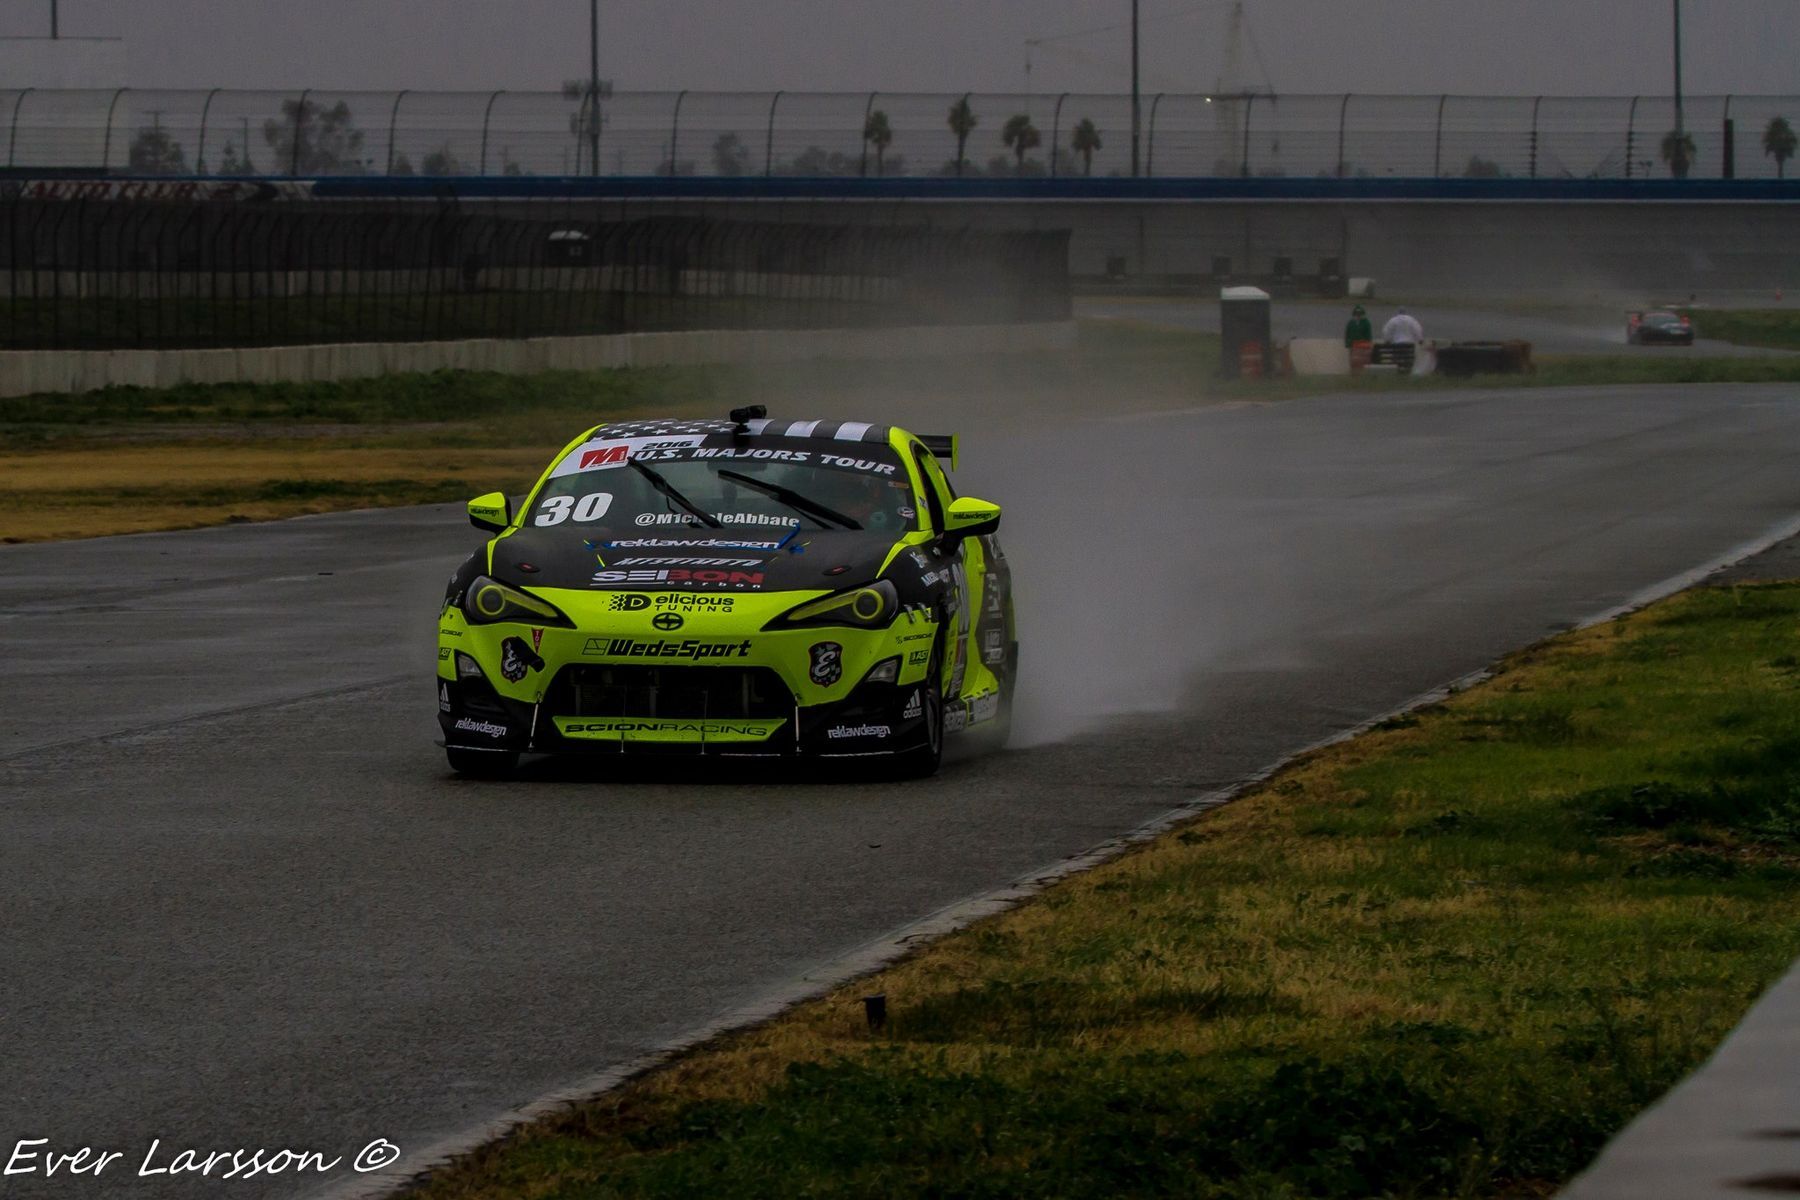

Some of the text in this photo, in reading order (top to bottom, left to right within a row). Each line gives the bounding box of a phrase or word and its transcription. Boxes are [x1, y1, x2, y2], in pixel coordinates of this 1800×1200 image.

[642, 440, 694, 449] 2016
[635, 448, 683, 461] U.S.
[692, 448, 811, 461] MAJORS
[820, 453, 896, 475] TOUR
[534, 492, 614, 527] 30
[611, 538, 780, 550] reklawdesign
[591, 569, 765, 584] SEIBON
[666, 580, 761, 589] carbon
[654, 604, 733, 613] TUNING
[607, 639, 752, 660] WedsSport
[827, 723, 892, 739] reklawdesign
